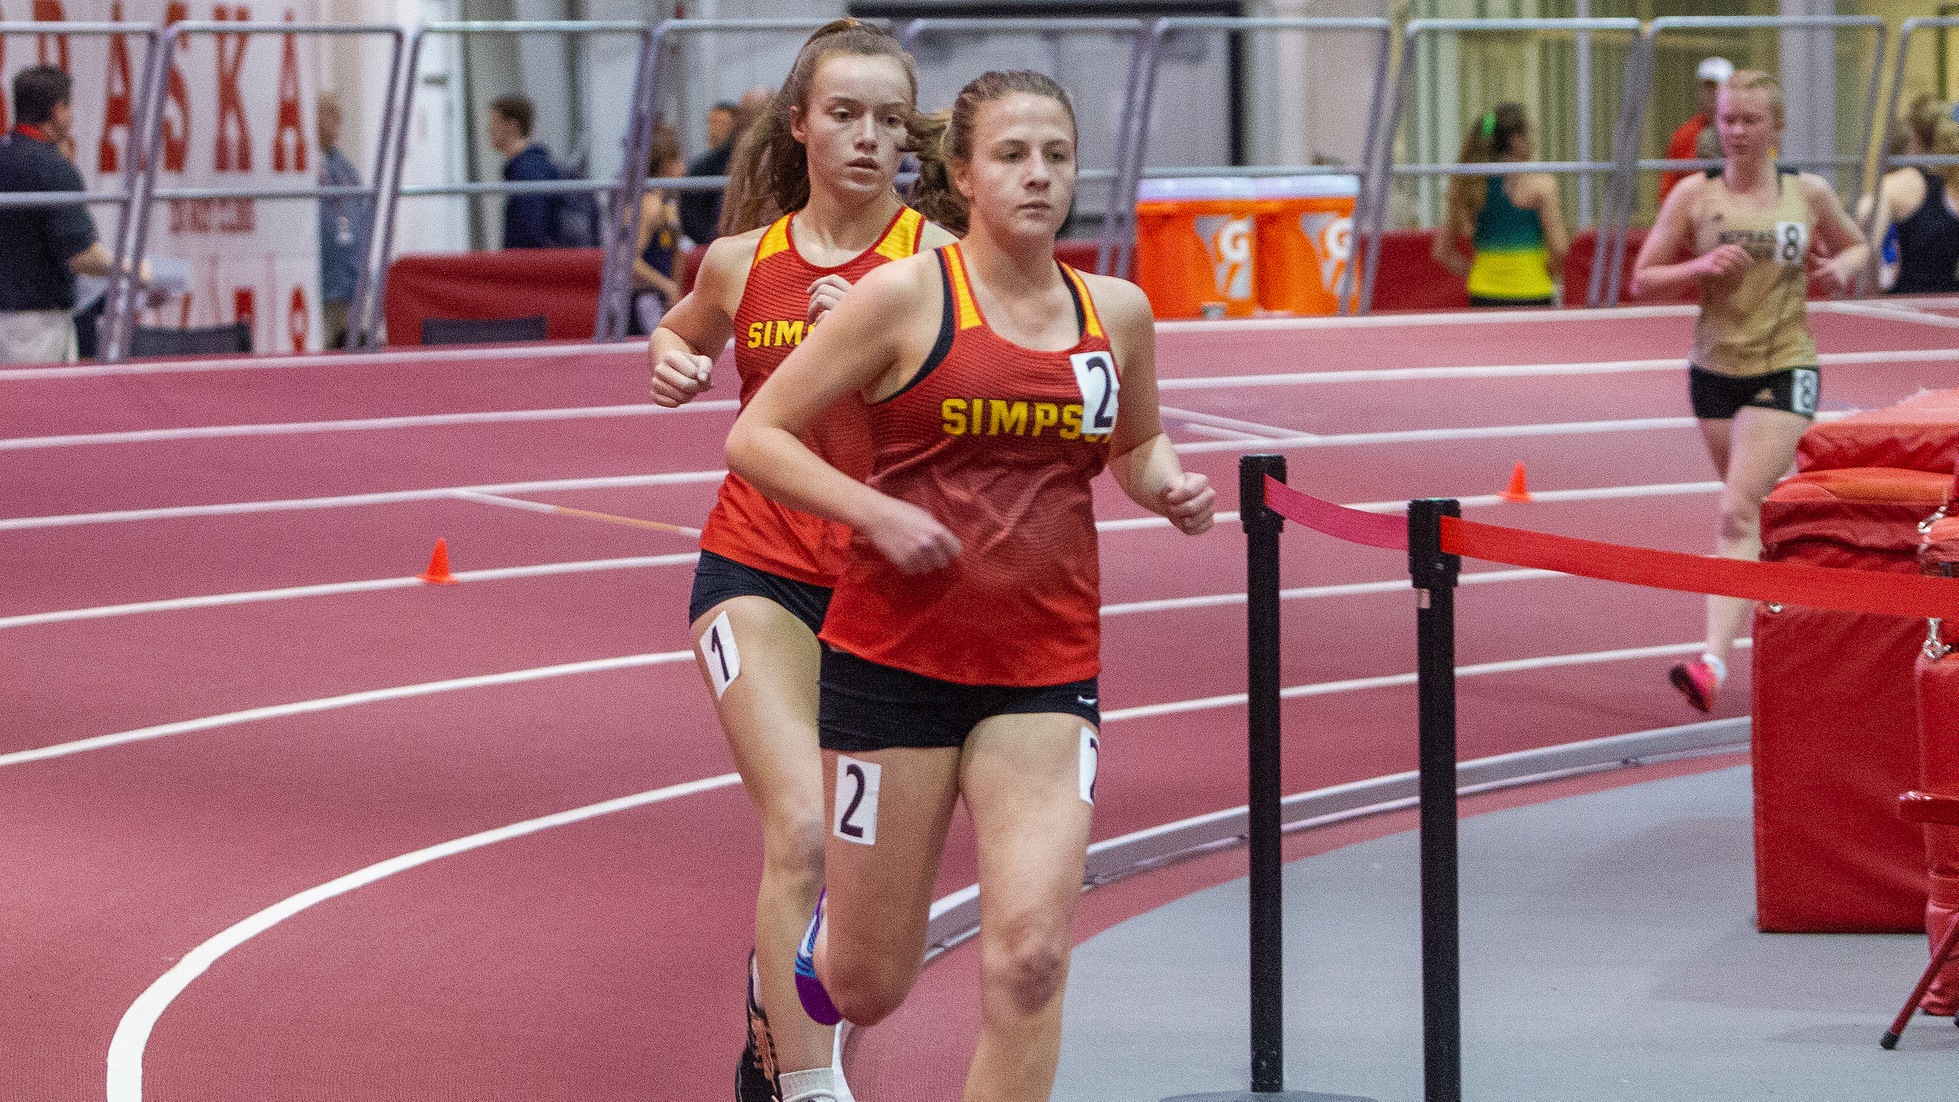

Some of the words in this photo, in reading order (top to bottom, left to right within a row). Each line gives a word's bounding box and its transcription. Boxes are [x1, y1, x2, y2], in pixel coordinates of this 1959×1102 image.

[1783, 224, 1799, 260] 8
[747, 320, 817, 349] SIM
[1086, 356, 1113, 428] 2
[942, 399, 1112, 443] SIMPS
[711, 625, 731, 682] 1
[840, 763, 865, 838] 2
